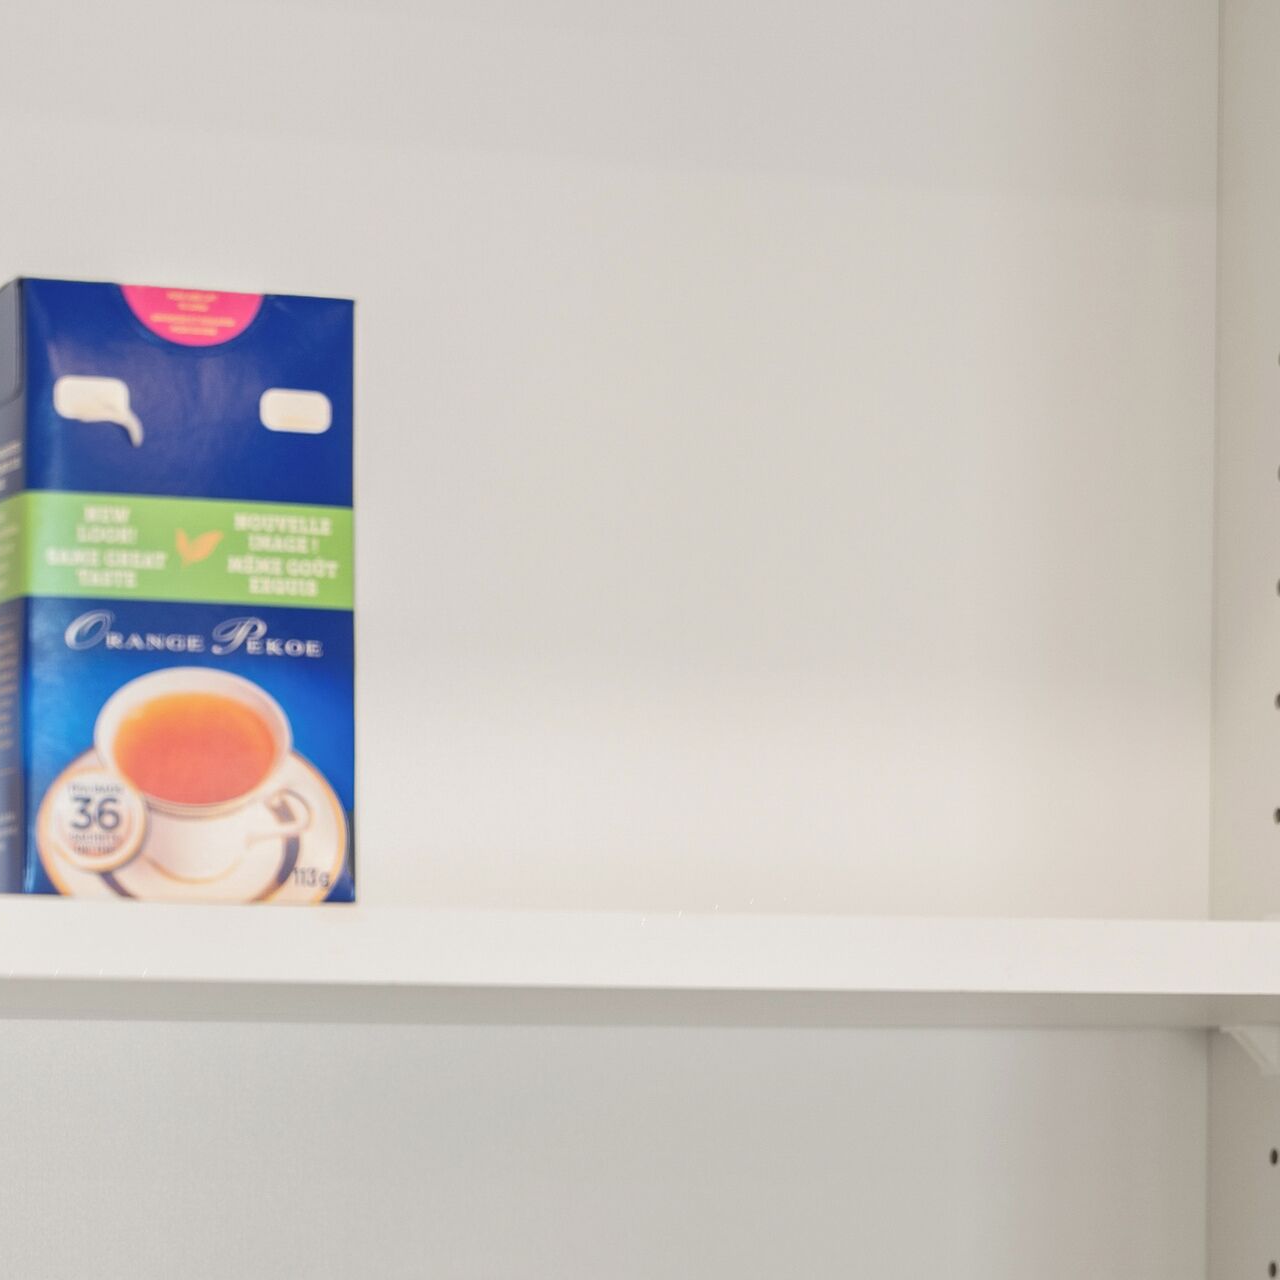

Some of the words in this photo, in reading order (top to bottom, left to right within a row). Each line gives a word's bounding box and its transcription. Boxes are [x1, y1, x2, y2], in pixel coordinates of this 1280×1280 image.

[64, 610, 204, 652] ORANGE
[211, 616, 323, 658] PEKOE
[71, 797, 121, 831] 36
